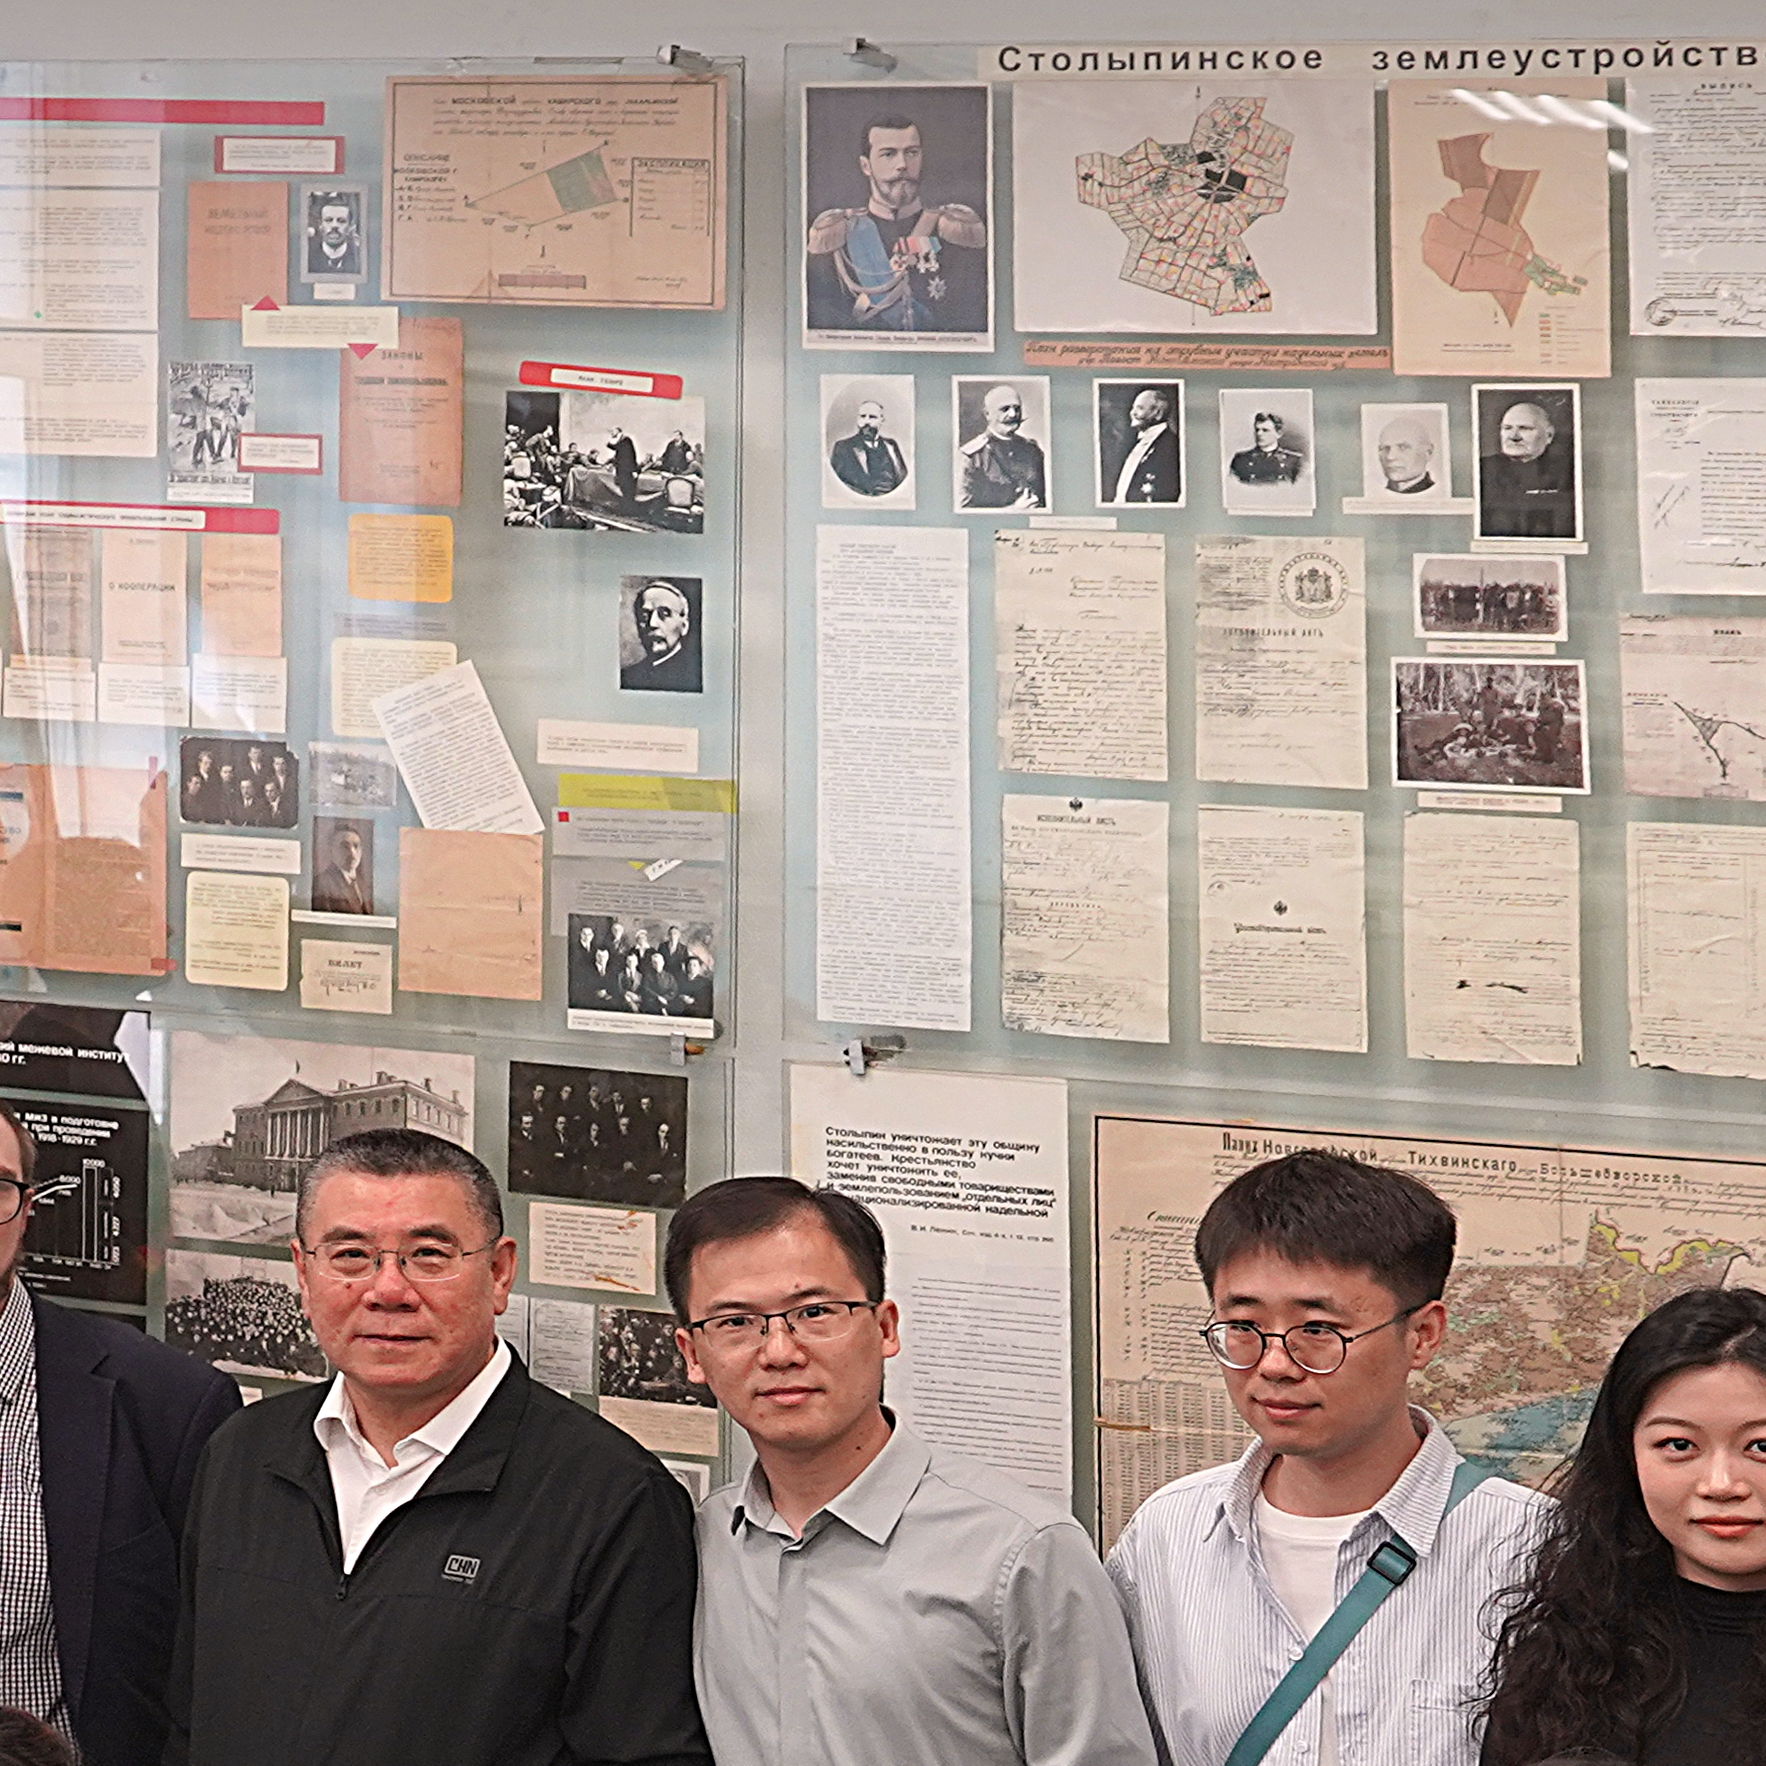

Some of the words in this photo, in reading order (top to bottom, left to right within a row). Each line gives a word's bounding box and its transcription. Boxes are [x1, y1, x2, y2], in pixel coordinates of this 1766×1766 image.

[998, 45, 1323, 73] Столыпинское
[18, 1043, 73, 1057] межевой
[826, 1127, 886, 1139] Столыпин
[891, 1131, 962, 1145] уничтожает
[968, 1139, 987, 1149] эту
[993, 1140, 1040, 1153] общину
[826, 1139, 916, 1153] насильственно
[922, 1146, 928, 1154] в
[932, 1146, 974, 1159] пользу
[981, 1151, 1015, 1161] кучки
[827, 1160, 859, 1171] хочет
[867, 1164, 938, 1177] уничтожить
[944, 1170, 962, 1179] ее,
[891, 1153, 976, 1169] Крестьянство
[839, 1183, 959, 1199] землепользованием
[881, 1175, 956, 1189] свободными
[959, 1181, 1055, 1196] товариществами
[985, 1205, 1048, 1218] надельной
